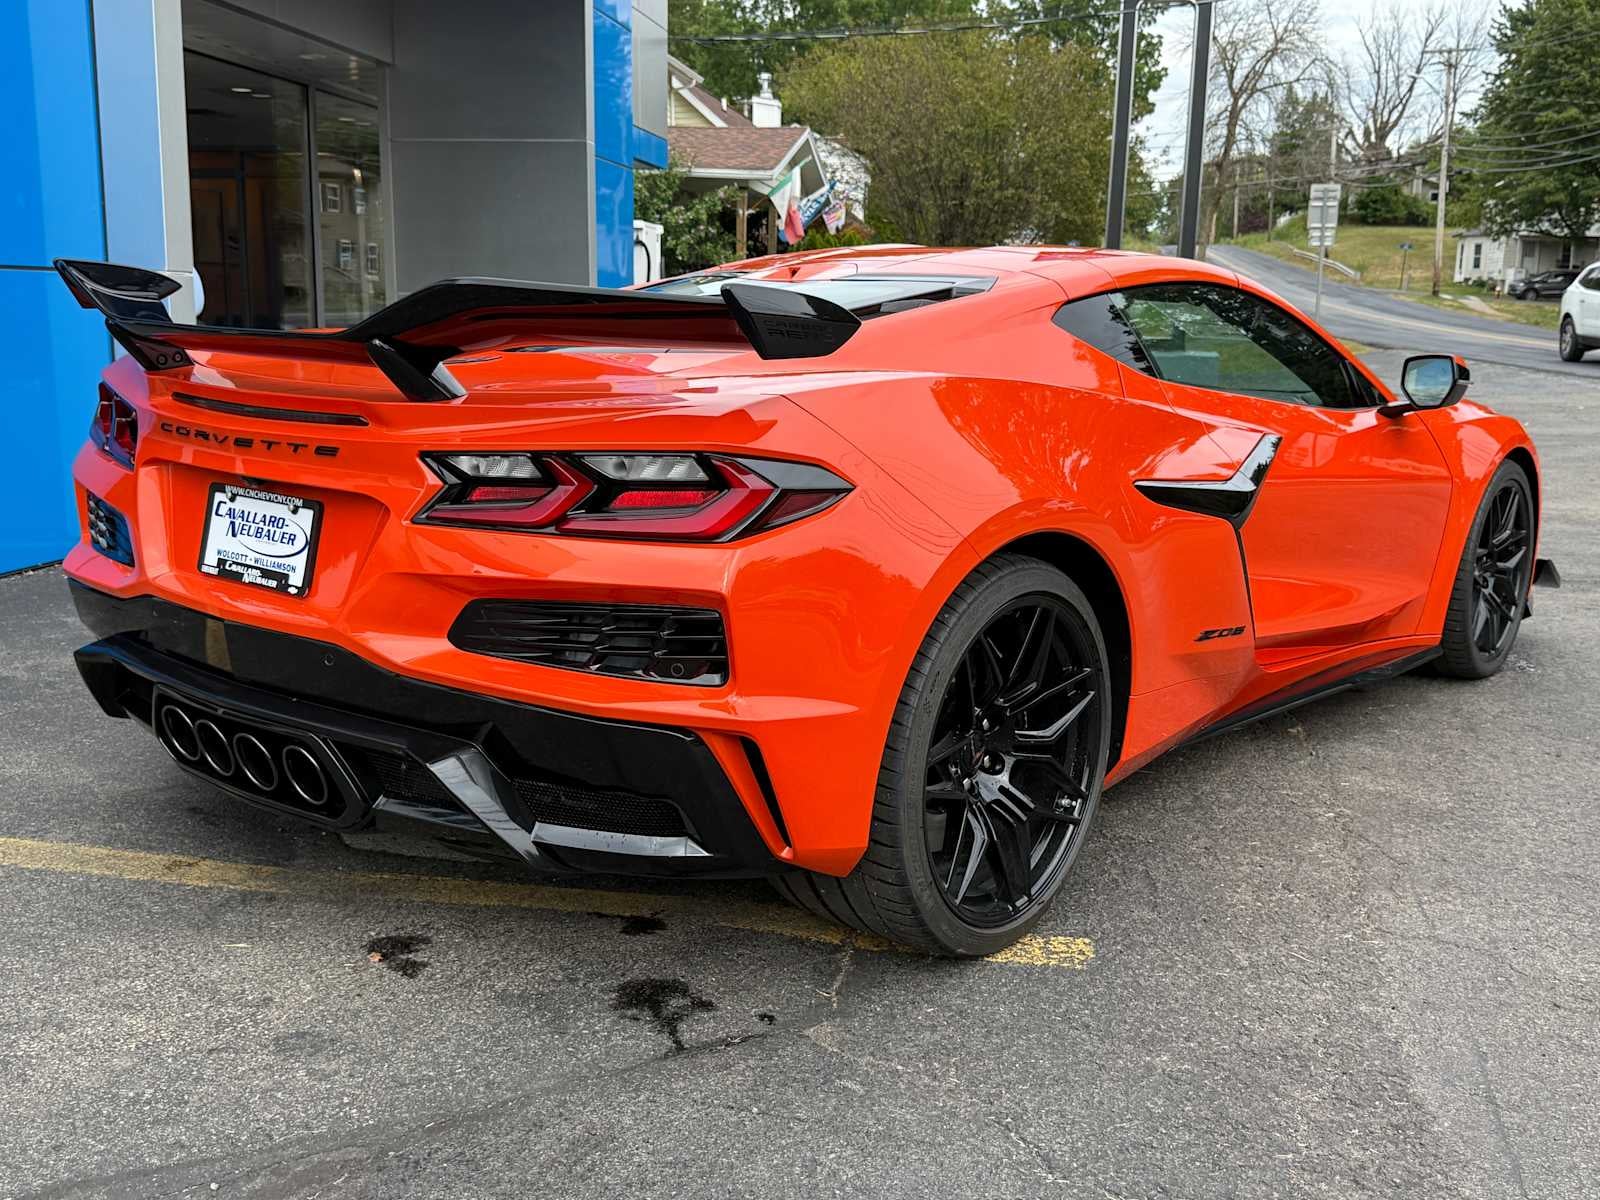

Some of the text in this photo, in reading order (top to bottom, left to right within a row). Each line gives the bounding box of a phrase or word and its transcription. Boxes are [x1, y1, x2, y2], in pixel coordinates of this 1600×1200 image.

[160, 421, 341, 457] CORVETTE
[225, 485, 303, 506] WWW.CNCHEVYCNY.COM
[215, 501, 289, 529] CAVALLARO-
[226, 521, 296, 546] NEUBAUER
[217, 549, 297, 573] WOLCOTT WILLIAMSON
